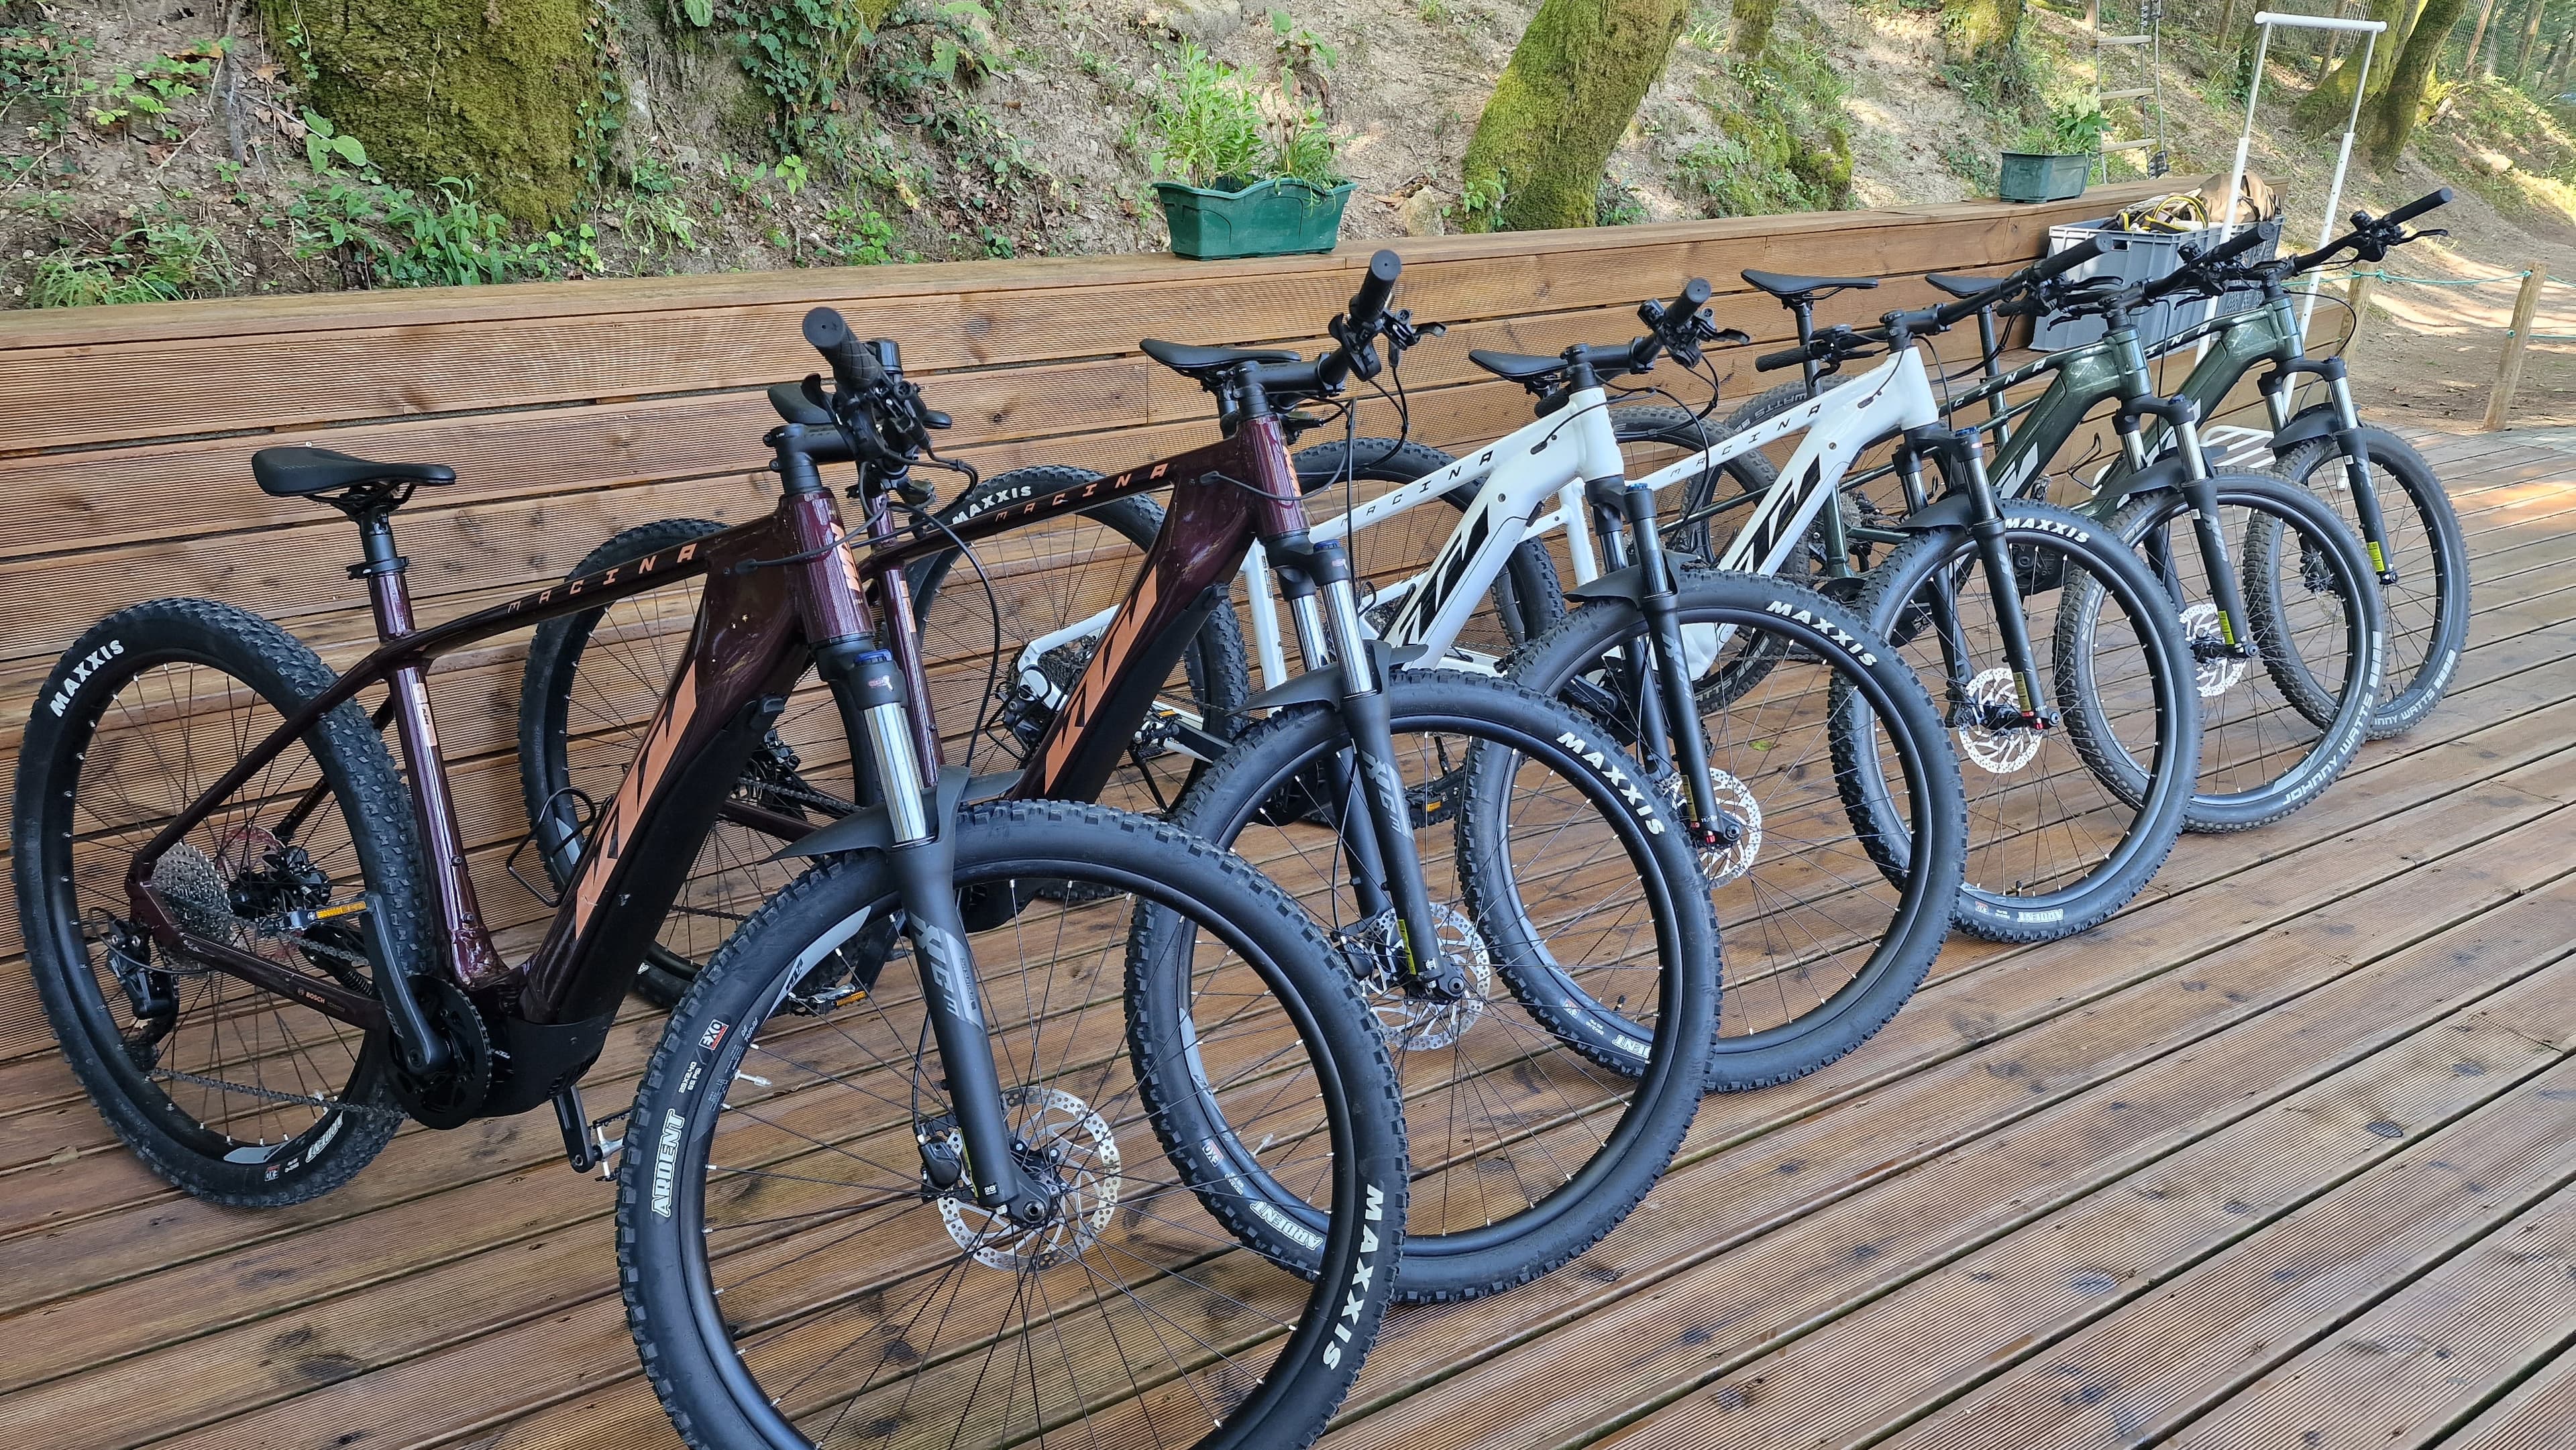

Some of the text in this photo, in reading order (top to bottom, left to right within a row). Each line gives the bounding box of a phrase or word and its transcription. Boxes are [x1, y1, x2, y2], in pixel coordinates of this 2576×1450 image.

[953, 486, 1032, 524] MAXXIS
[996, 463, 1169, 522] MACINA
[2005, 518, 2090, 543] MAXXIS
[508, 543, 698, 613] MACINA
[1766, 600, 1878, 666] MAXXIS
[50, 639, 124, 717] MAXXIS
[1695, 677, 1732, 702] ATTS
[2400, 688, 2435, 720] WATTS
[2340, 691, 2373, 756] WATTS
[1556, 732, 1665, 834] MAXXIS
[306, 991, 325, 1004] BOSCH
[700, 1020, 725, 1046] EXO
[651, 1109, 685, 1217] ARDENT
[1203, 1142, 1220, 1166] EXO
[1250, 1201, 1323, 1250] ARDENT
[1323, 1184, 1383, 1370] MAXXIS
